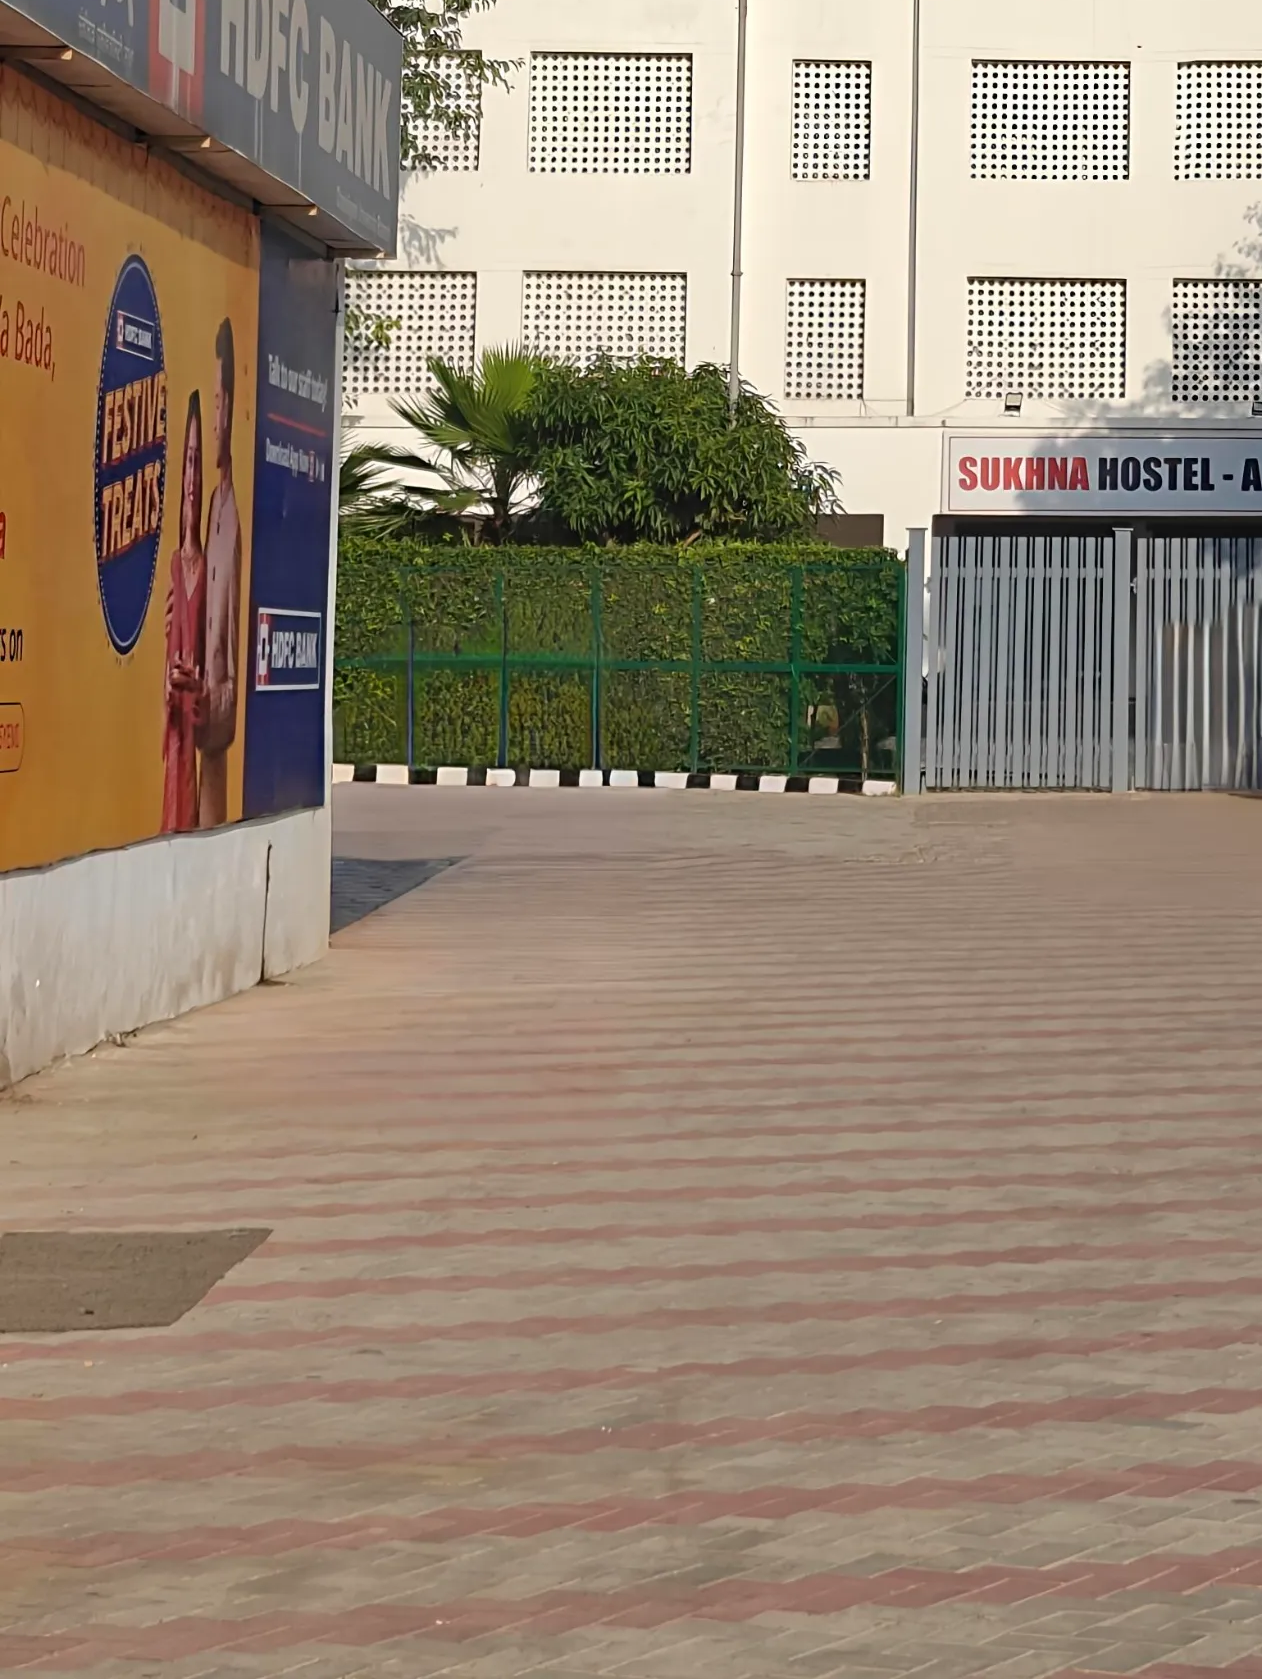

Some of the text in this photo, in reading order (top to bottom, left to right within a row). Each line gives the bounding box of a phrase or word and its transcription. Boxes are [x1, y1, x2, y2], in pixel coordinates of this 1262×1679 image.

[318, 15, 392, 201] BANK
[1, 195, 86, 287] Celebration
[15, 300, 56, 382] Bada,
[102, 370, 167, 465] FESTIVE
[101, 459, 162, 559] TREATS
[958, 456, 1090, 492] SUKHNA
[1099, 457, 1215, 492] HOSTEL
[1241, 458, 1262, 491] A
[271, 631, 317, 669] HDFC BANK
